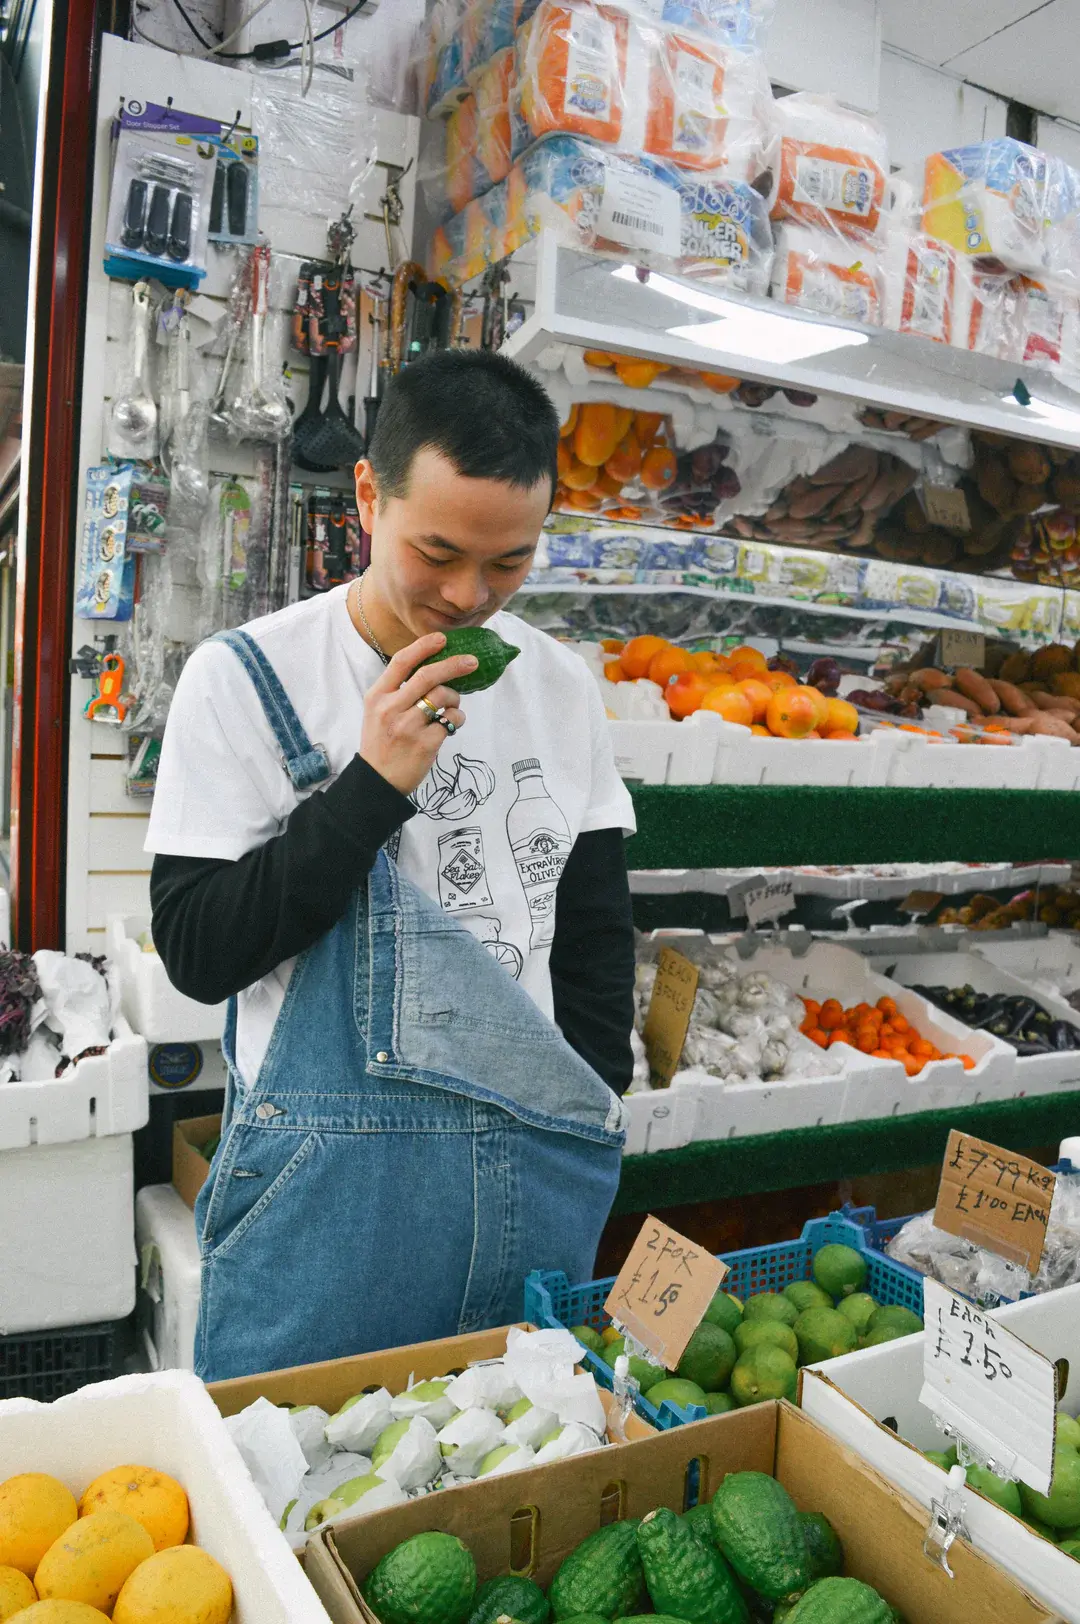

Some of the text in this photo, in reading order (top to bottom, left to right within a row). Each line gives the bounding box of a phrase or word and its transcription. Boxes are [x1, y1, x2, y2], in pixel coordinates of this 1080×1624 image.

[444, 865, 460, 873] Sea
[529, 867, 556, 882] OLIVE
[646, 1228, 661, 1251] 2
